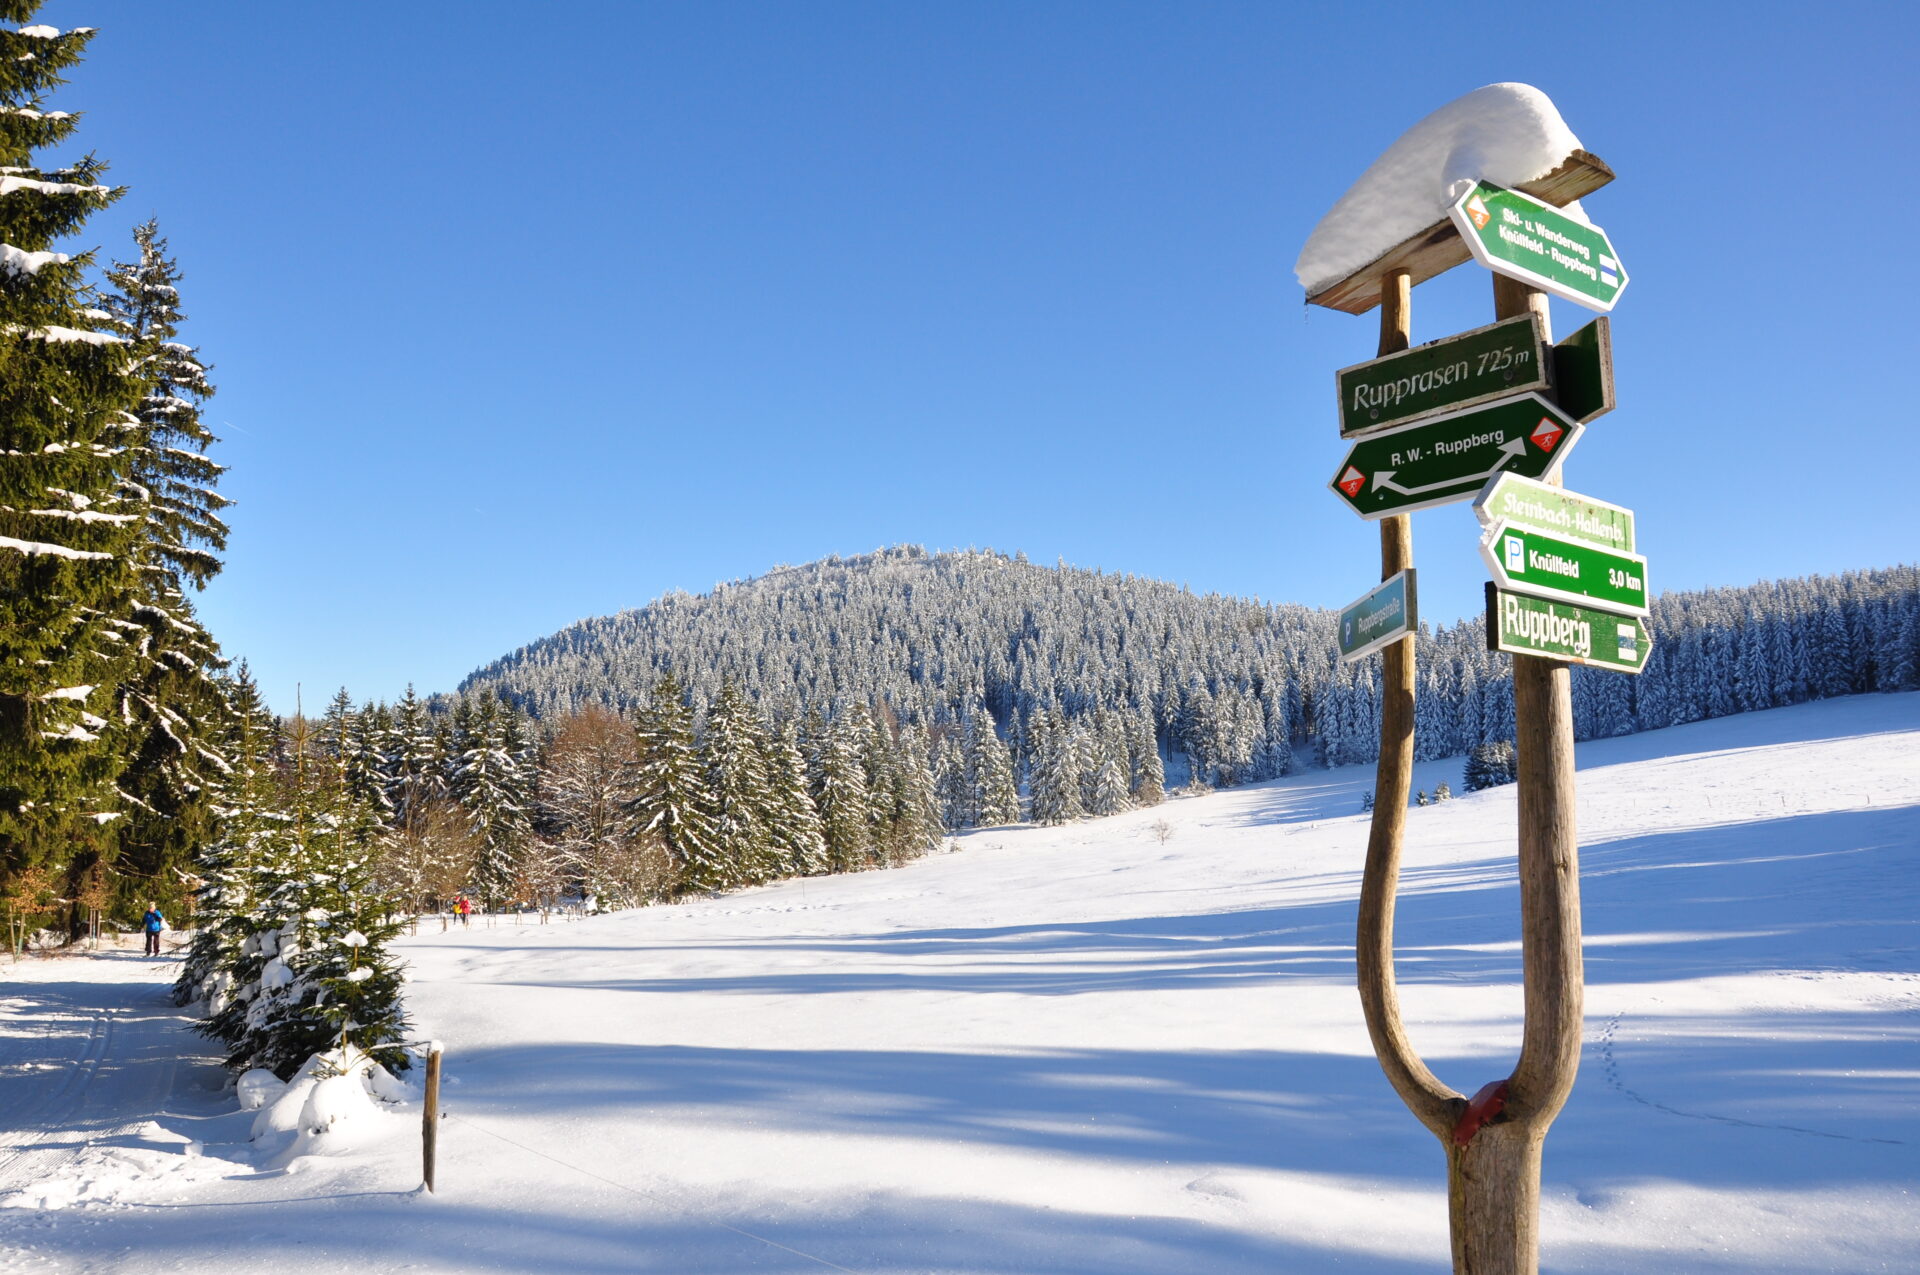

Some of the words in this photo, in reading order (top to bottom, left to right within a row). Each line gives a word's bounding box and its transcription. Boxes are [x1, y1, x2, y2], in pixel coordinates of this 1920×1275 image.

[1499, 224, 1544, 256] Knüllfeld
[1551, 246, 1597, 281] Ruppberg
[1502, 207, 1523, 227] Ski-
[1525, 221, 1535, 233] u.
[1535, 221, 1590, 260] Wanderweg
[1353, 360, 1468, 411] Rupprasen
[1476, 346, 1514, 376] 725
[1515, 350, 1530, 365] m
[1391, 452, 1405, 467] R.
[1407, 447, 1424, 463] W.
[1435, 429, 1504, 456] Ruppberg
[1509, 540, 1521, 568] P
[1529, 549, 1580, 578] Knüllfeld
[1609, 567, 1625, 590] 3,0
[1625, 571, 1642, 591] km
[1505, 595, 1591, 658] Ruppberg
